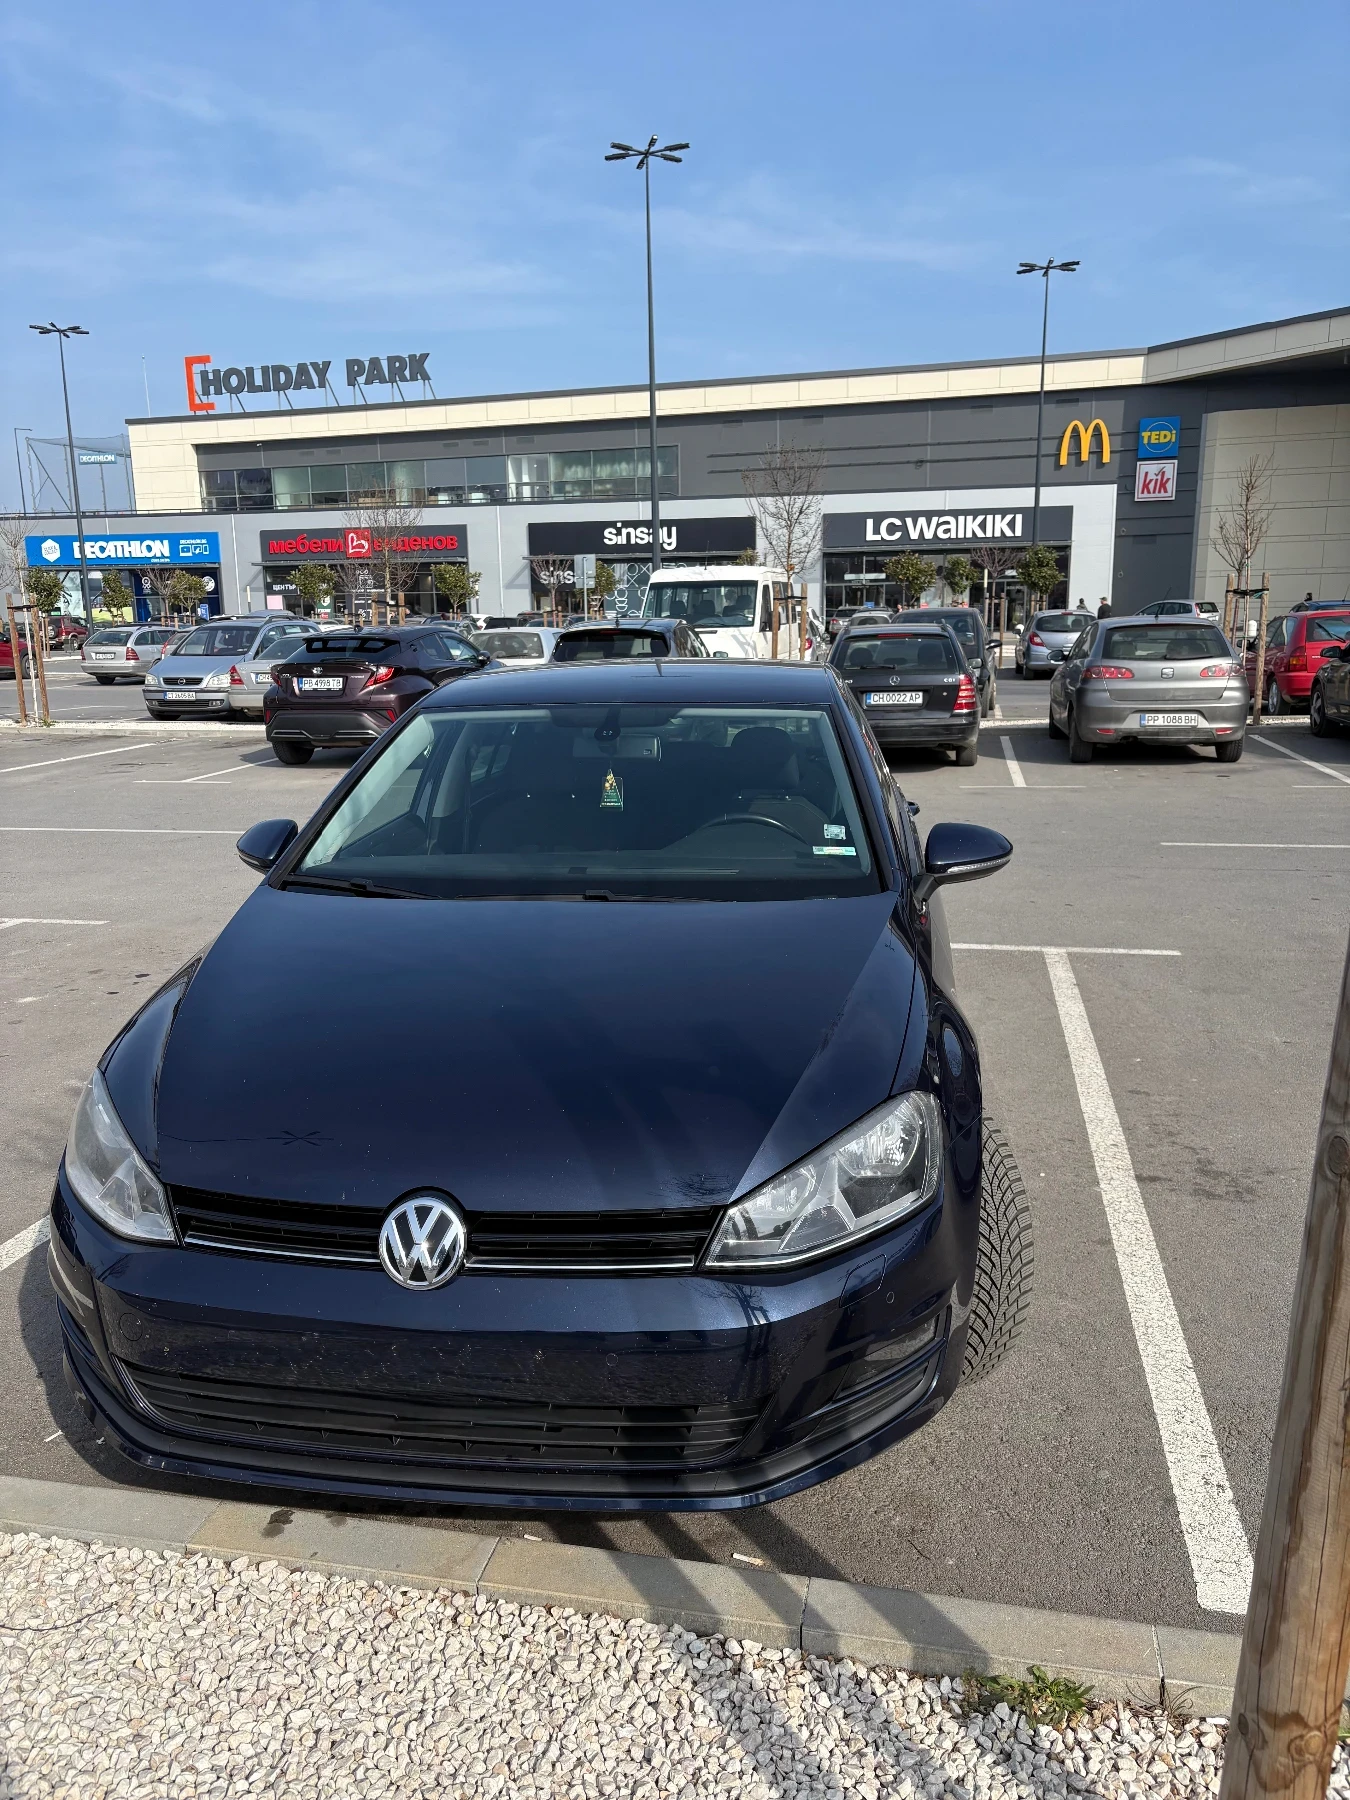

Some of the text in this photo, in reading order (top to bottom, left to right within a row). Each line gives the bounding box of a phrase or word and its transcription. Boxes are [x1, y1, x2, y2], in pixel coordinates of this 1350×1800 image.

[200, 352, 432, 397] HOLIDAY PARK
[1141, 430, 1177, 445] TEDi
[79, 454, 115, 463] DECATHLON
[865, 517, 903, 541] LC
[269, 534, 344, 555] мебели
[872, 693, 921, 703] CH 0022 AP
[1146, 715, 1160, 724] PP
[1184, 715, 1197, 724] BH
